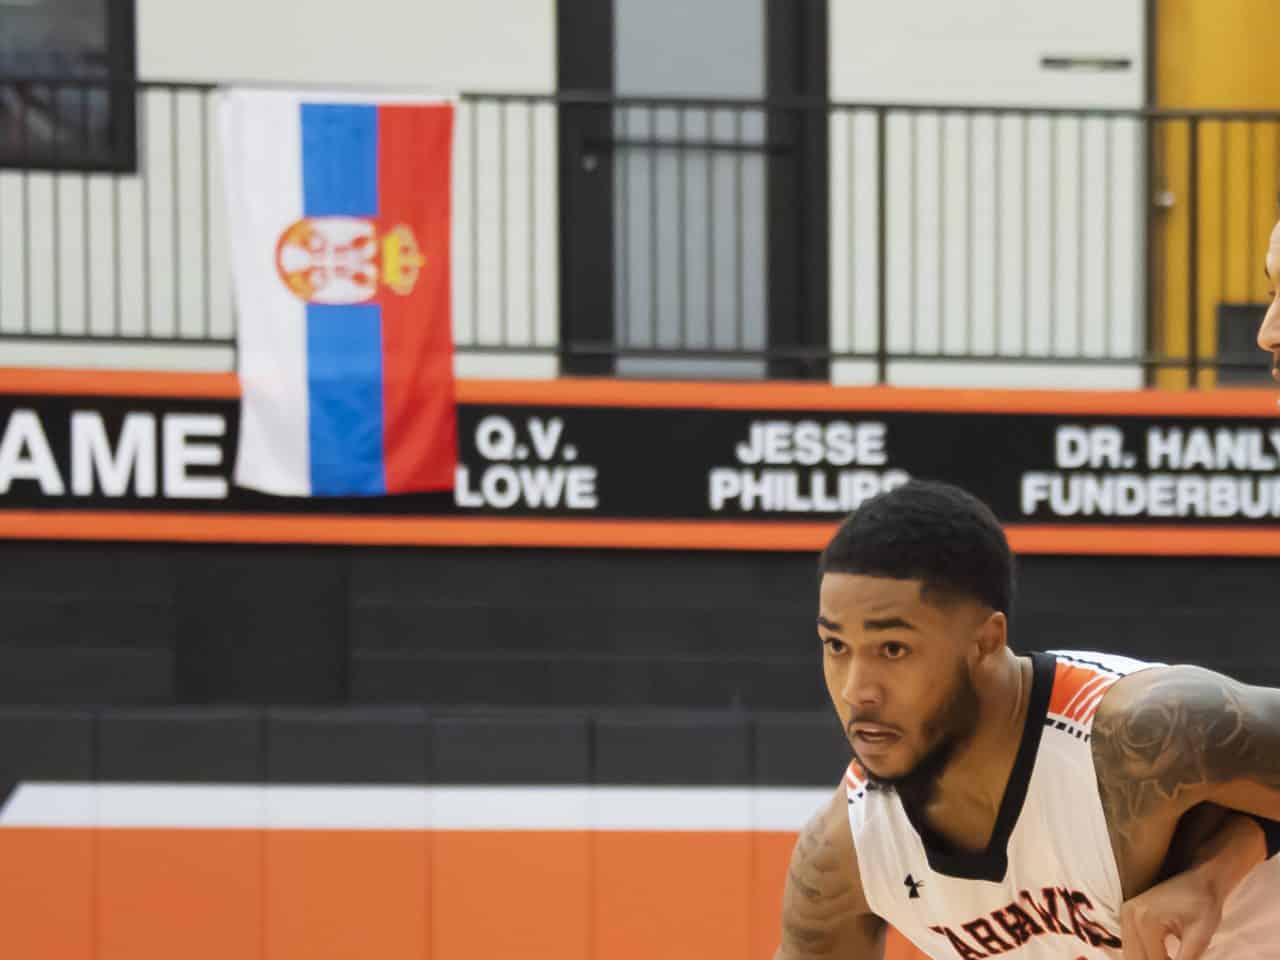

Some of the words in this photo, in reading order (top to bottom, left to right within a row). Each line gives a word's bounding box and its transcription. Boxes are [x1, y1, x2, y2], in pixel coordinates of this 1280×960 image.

[0, 409, 227, 498] AME
[475, 415, 578, 461] Q.V.
[736, 421, 887, 465] JESSE
[1055, 425, 1136, 469] DR.
[455, 464, 598, 508] LOWE
